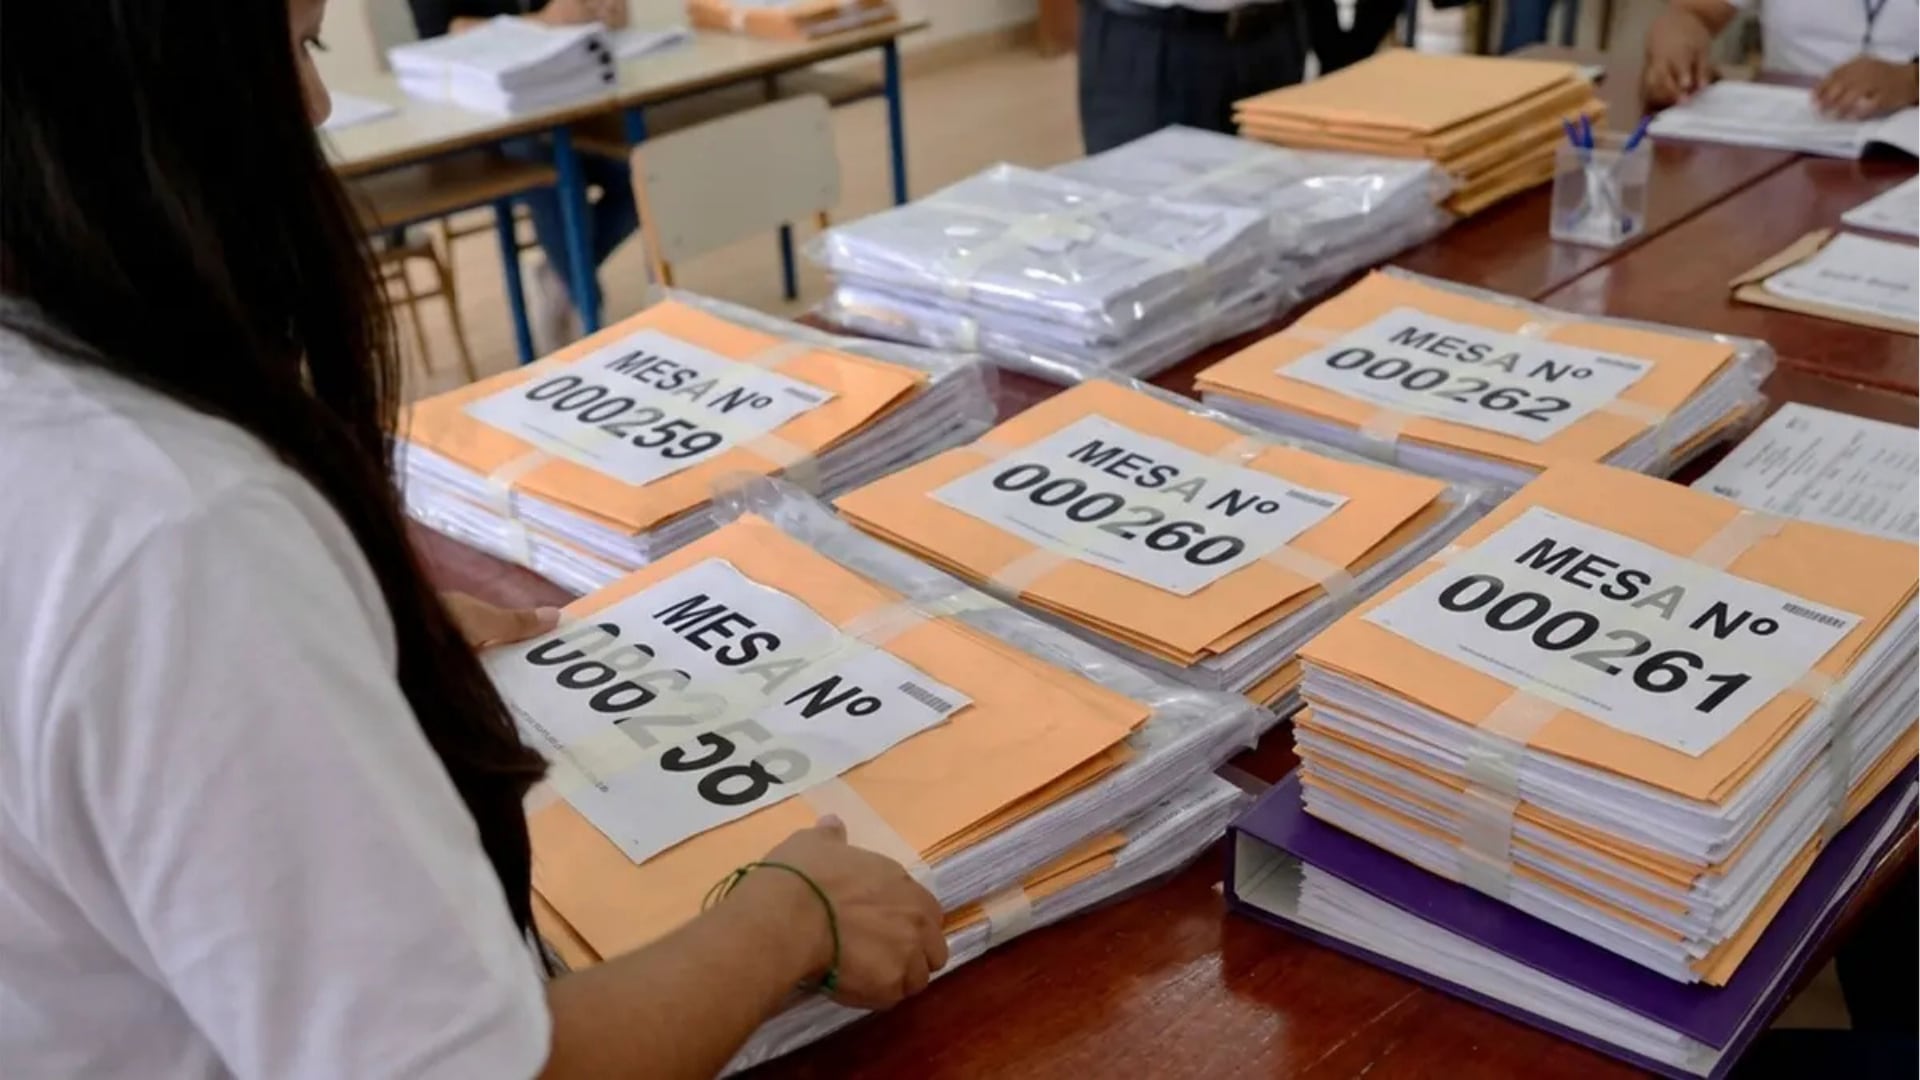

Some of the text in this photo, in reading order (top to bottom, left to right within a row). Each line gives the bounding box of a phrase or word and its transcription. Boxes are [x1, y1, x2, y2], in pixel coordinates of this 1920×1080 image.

[604, 350, 719, 402] MESA
[1325, 347, 1572, 423] 000262
[1388, 326, 1522, 373] MESA
[525, 375, 723, 460] 000259
[1068, 439, 1208, 503] MESA
[992, 463, 1246, 566] 000260
[1514, 537, 1687, 620] MESA
[653, 594, 808, 696] MESA
[1437, 573, 1752, 714] 000261
